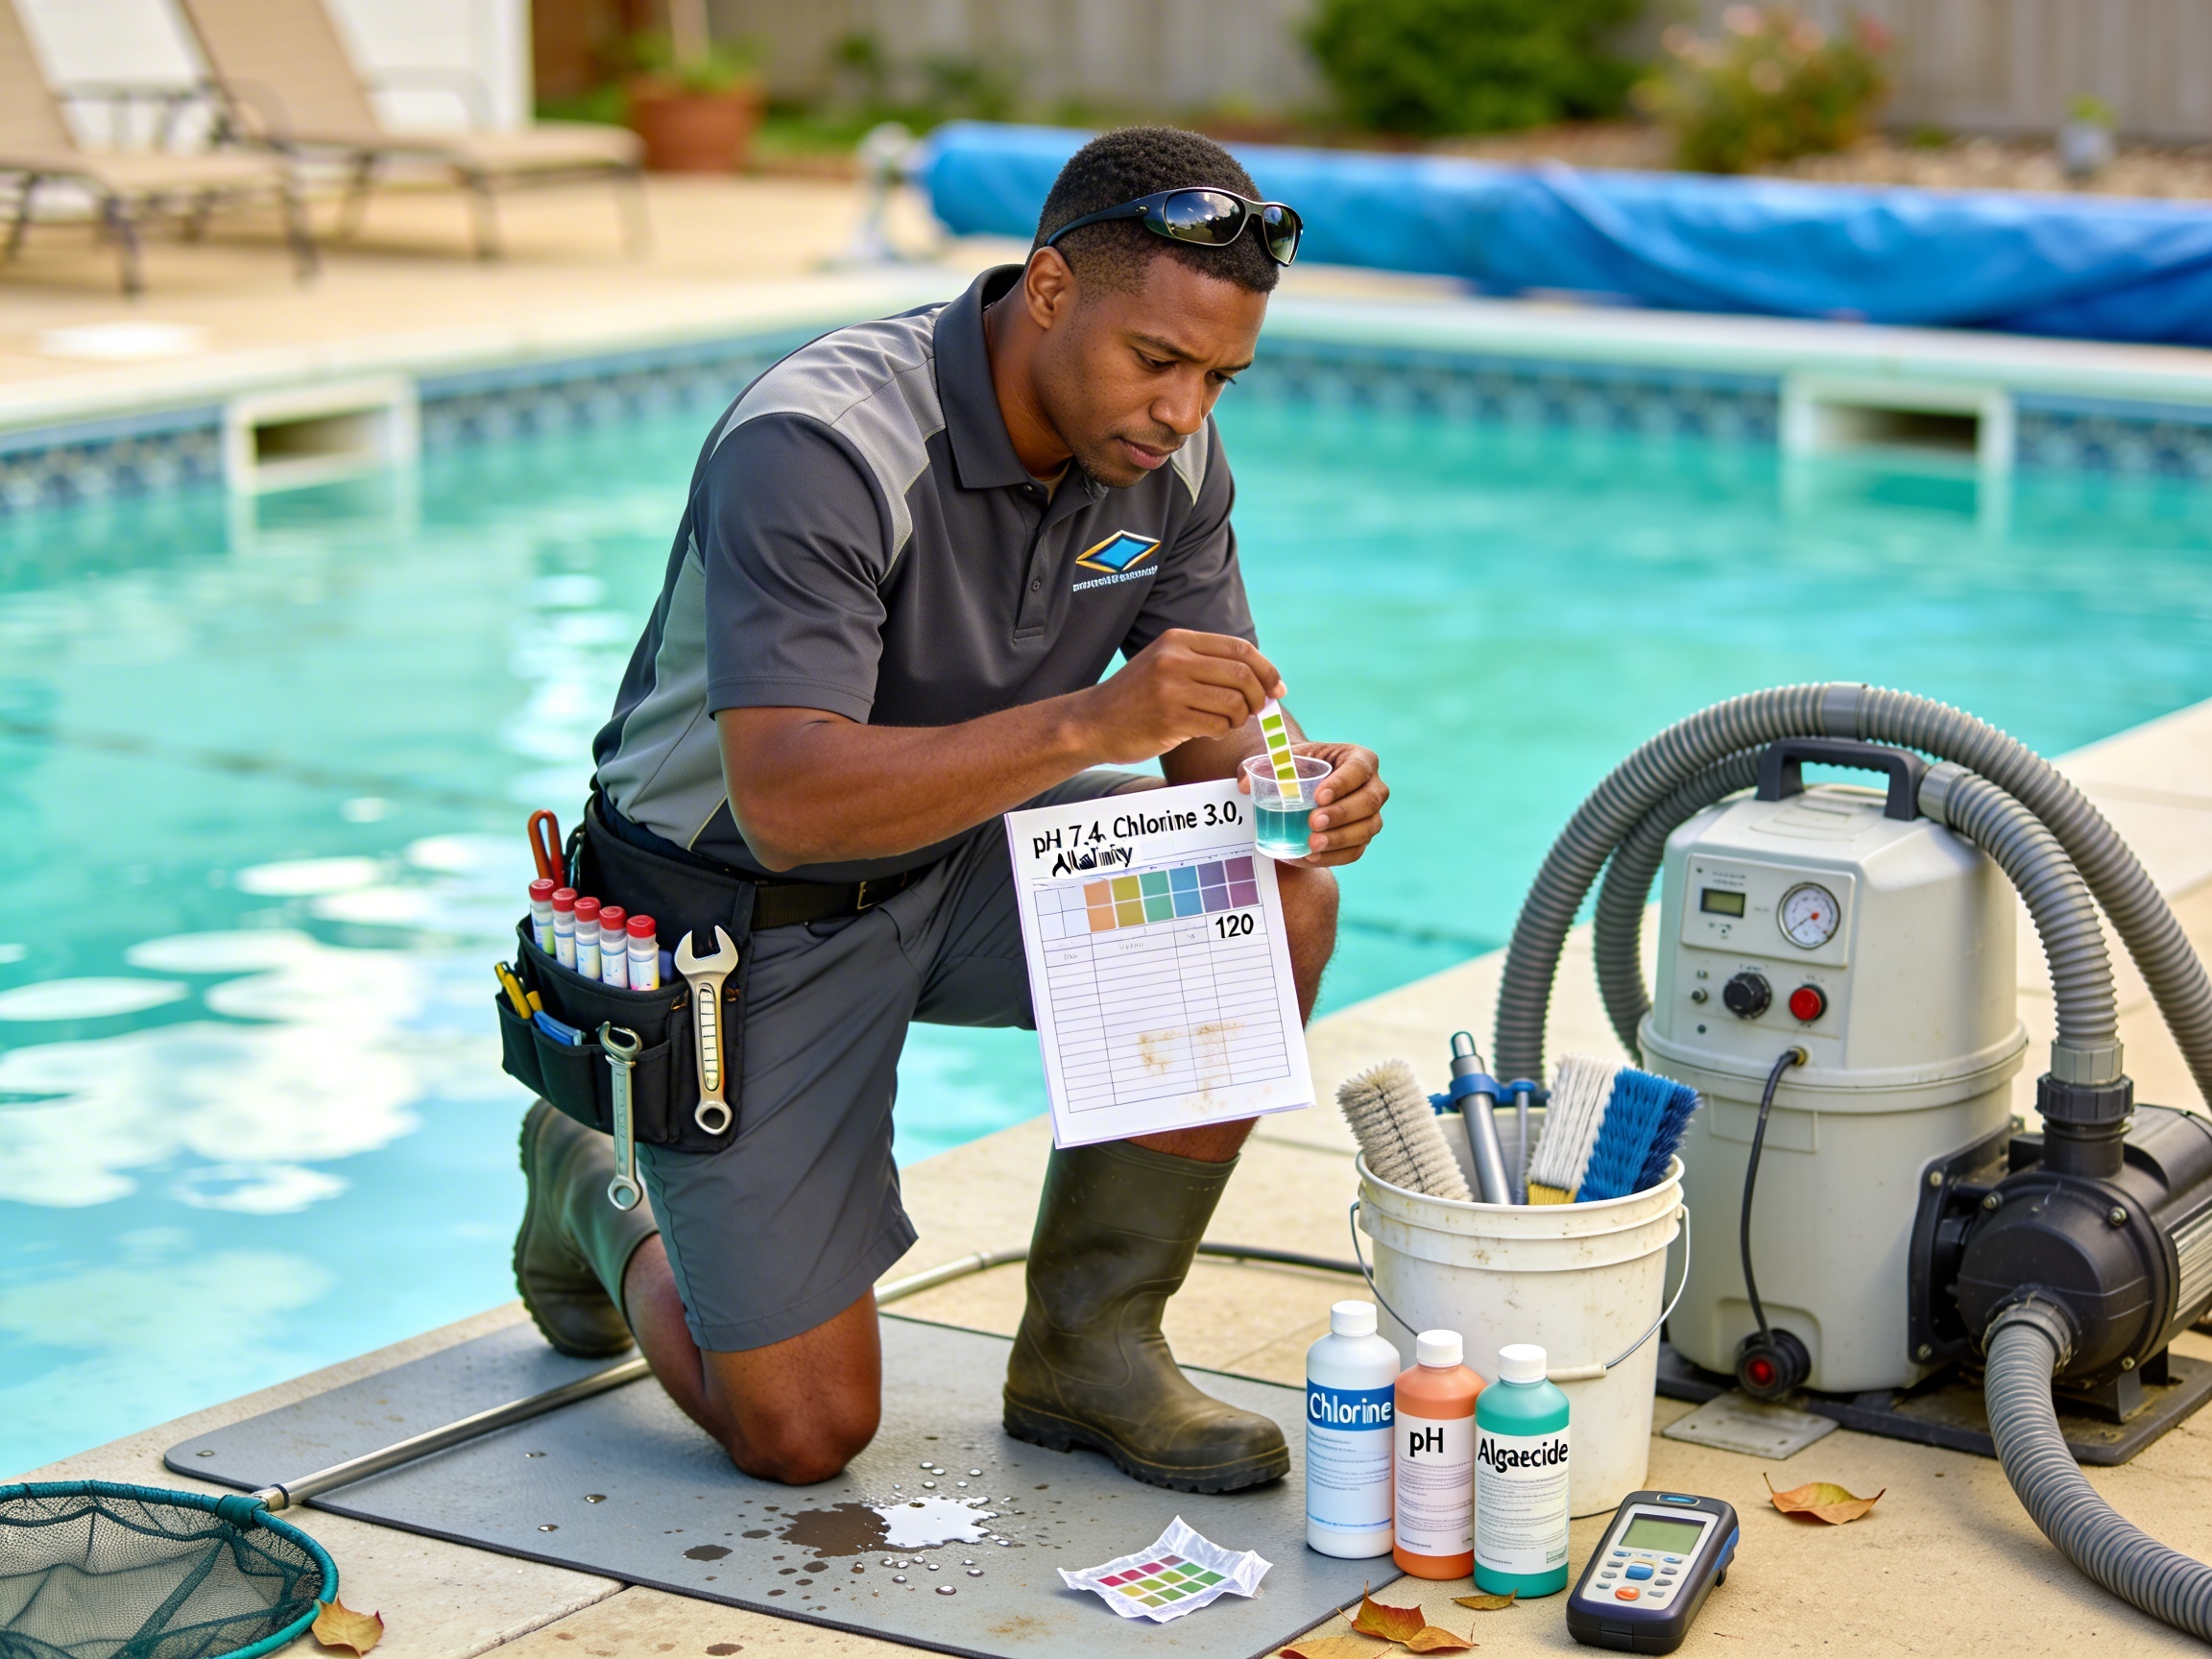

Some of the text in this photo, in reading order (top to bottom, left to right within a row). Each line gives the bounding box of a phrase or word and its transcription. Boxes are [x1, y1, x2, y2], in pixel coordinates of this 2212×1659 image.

[1033, 829, 1062, 858] pH
[1113, 809, 1197, 838] Chlorine
[1203, 800, 1243, 827] 3.0,
[1214, 913, 1254, 938] 120
[1309, 1392, 1392, 1425] Chlorine
[1409, 1427, 1444, 1456] pH
[1478, 1438, 1569, 1474] Algaecide
